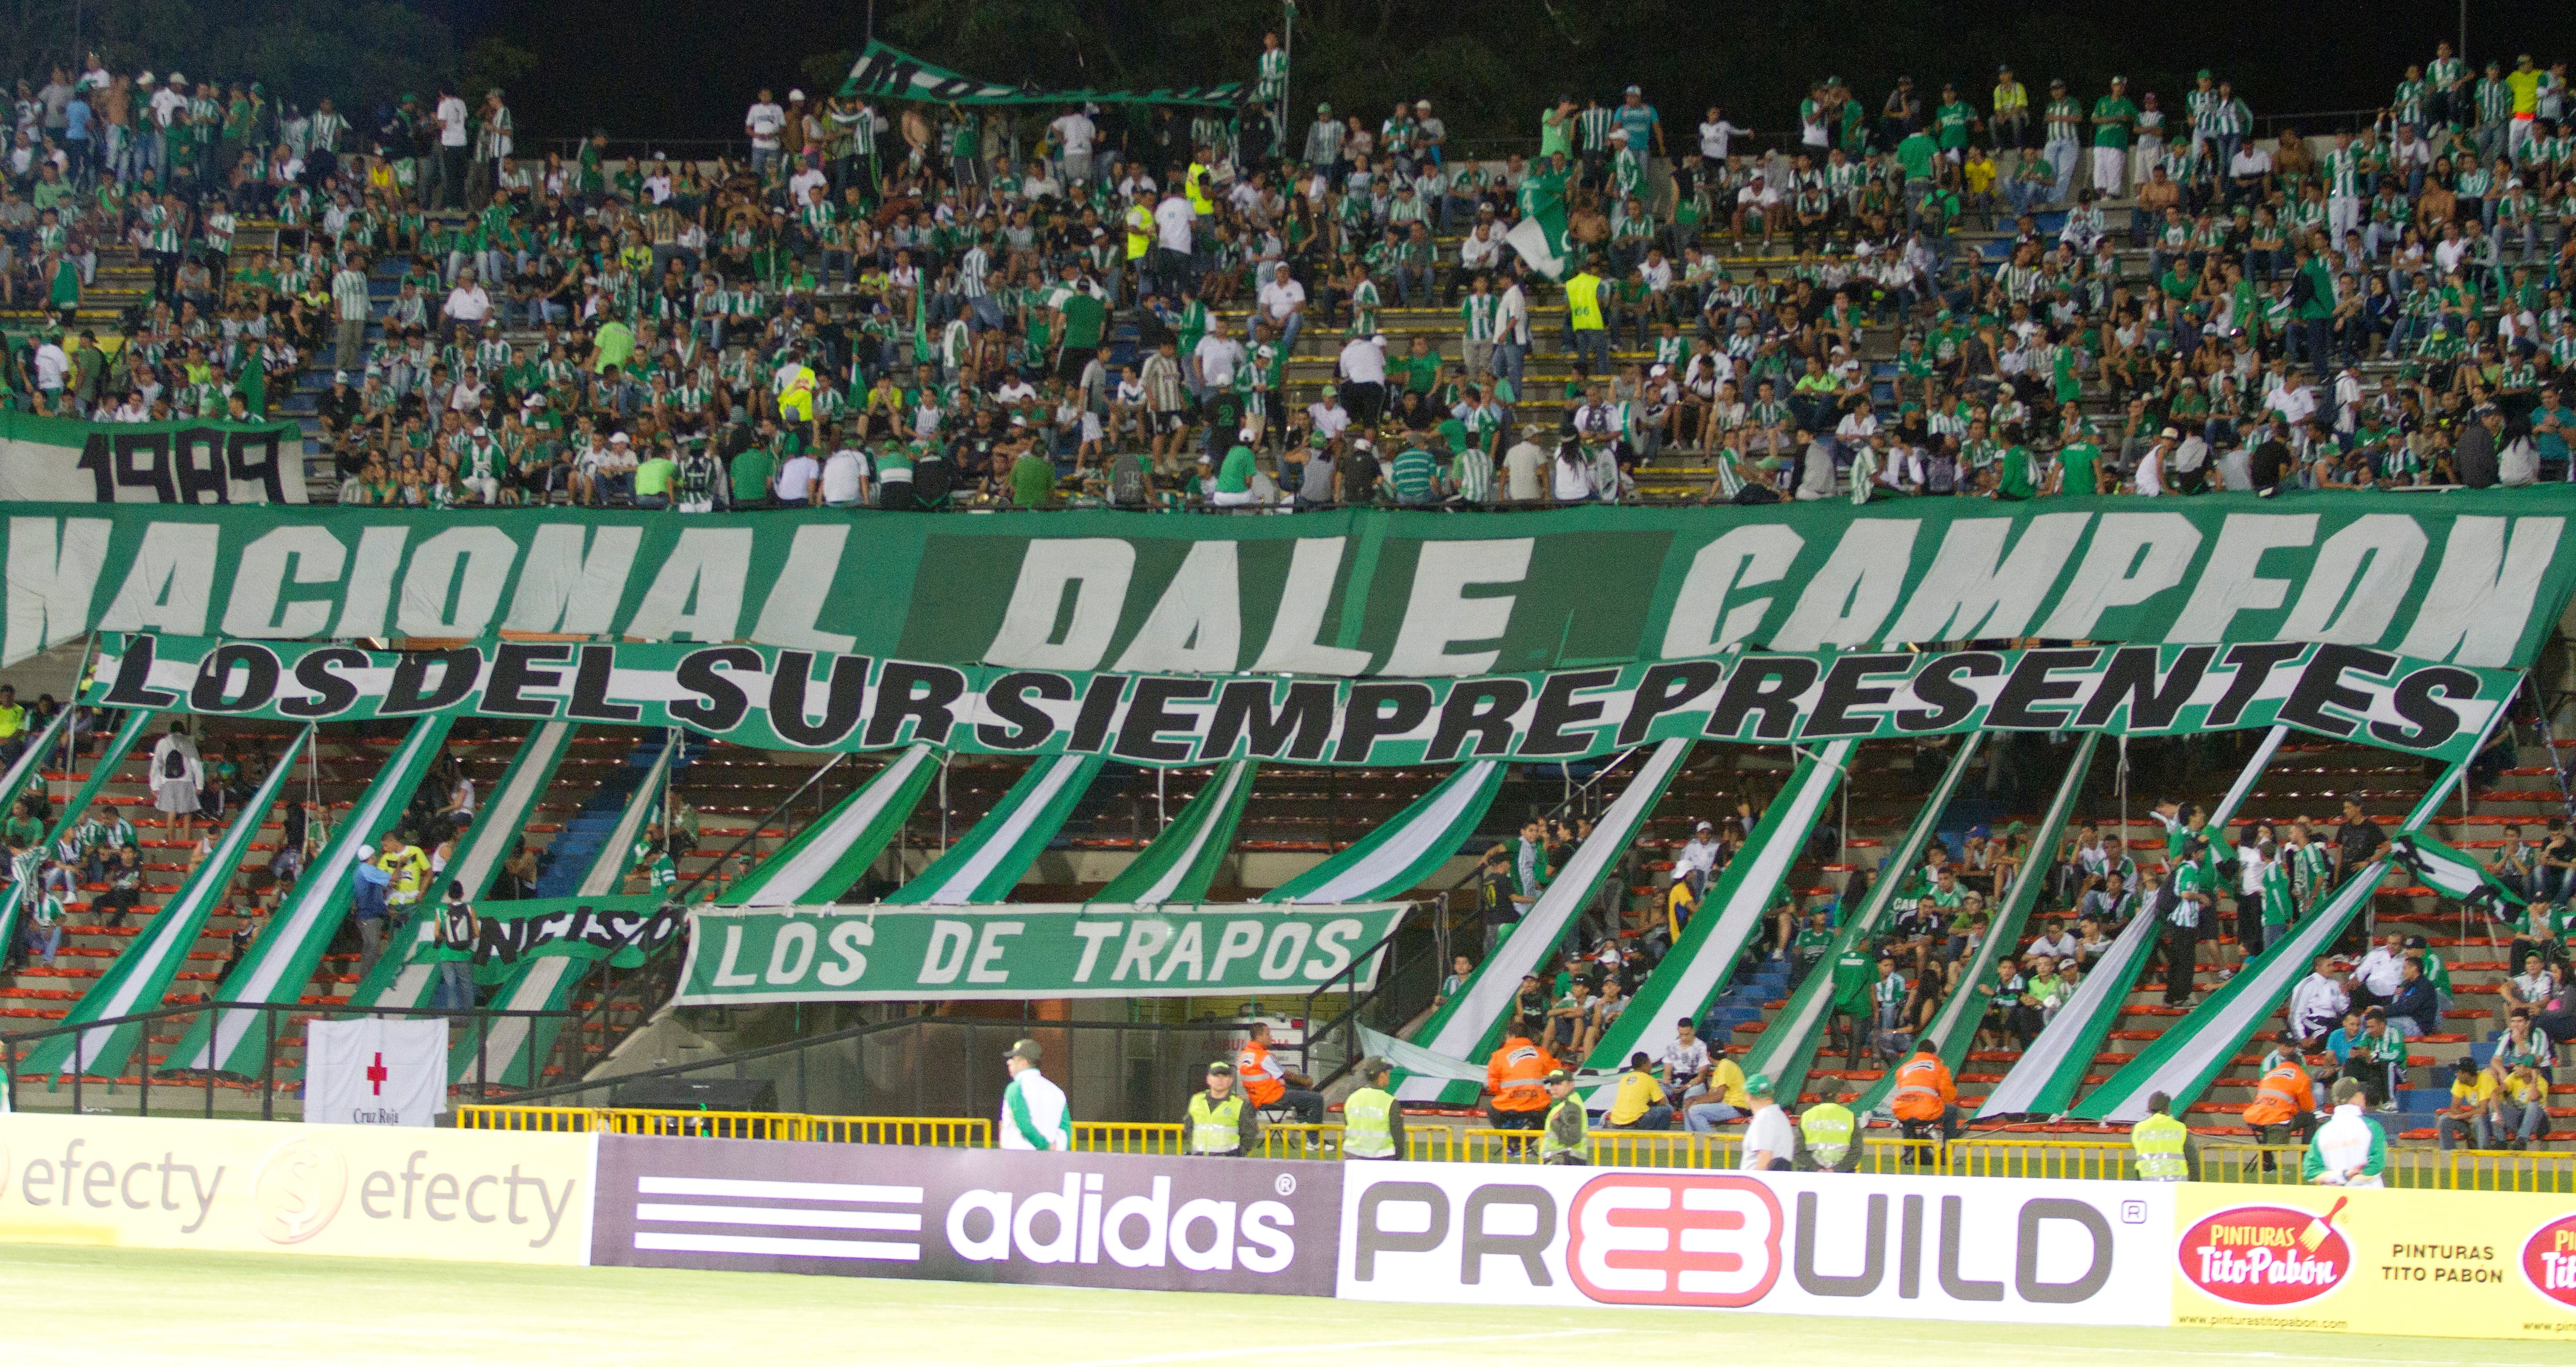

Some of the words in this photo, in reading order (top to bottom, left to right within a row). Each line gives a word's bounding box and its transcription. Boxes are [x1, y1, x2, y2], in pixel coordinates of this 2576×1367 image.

[77, 427, 286, 504] 1989
[0, 517, 858, 667] NACIONAL
[983, 537, 1536, 676] DALE
[101, 634, 372, 719] LOS
[375, 642, 644, 722] DEL
[667, 646, 968, 750] SUR
[974, 665, 1627, 764] SIEMPRE
[1613, 639, 2484, 751] PRESENTES
[713, 921, 874, 986] LOS
[917, 922, 1025, 984] DE
[1072, 920, 1363, 983] TRAPOS
[353, 1108, 377, 1124] Cruz
[379, 1108, 399, 1126] Roja
[22, 1139, 226, 1235] efecty
[361, 1151, 576, 1248] efecty
[946, 1171, 1295, 1273] adidas
[2210, 1224, 2295, 1247] PINTURAS
[2393, 1244, 2494, 1260] PINTURAS
[2382, 1266, 2426, 1281] TITO
[2435, 1264, 2503, 1283] PABÓN
[2179, 1315, 2348, 1328] www.pinturastitopabon.com
